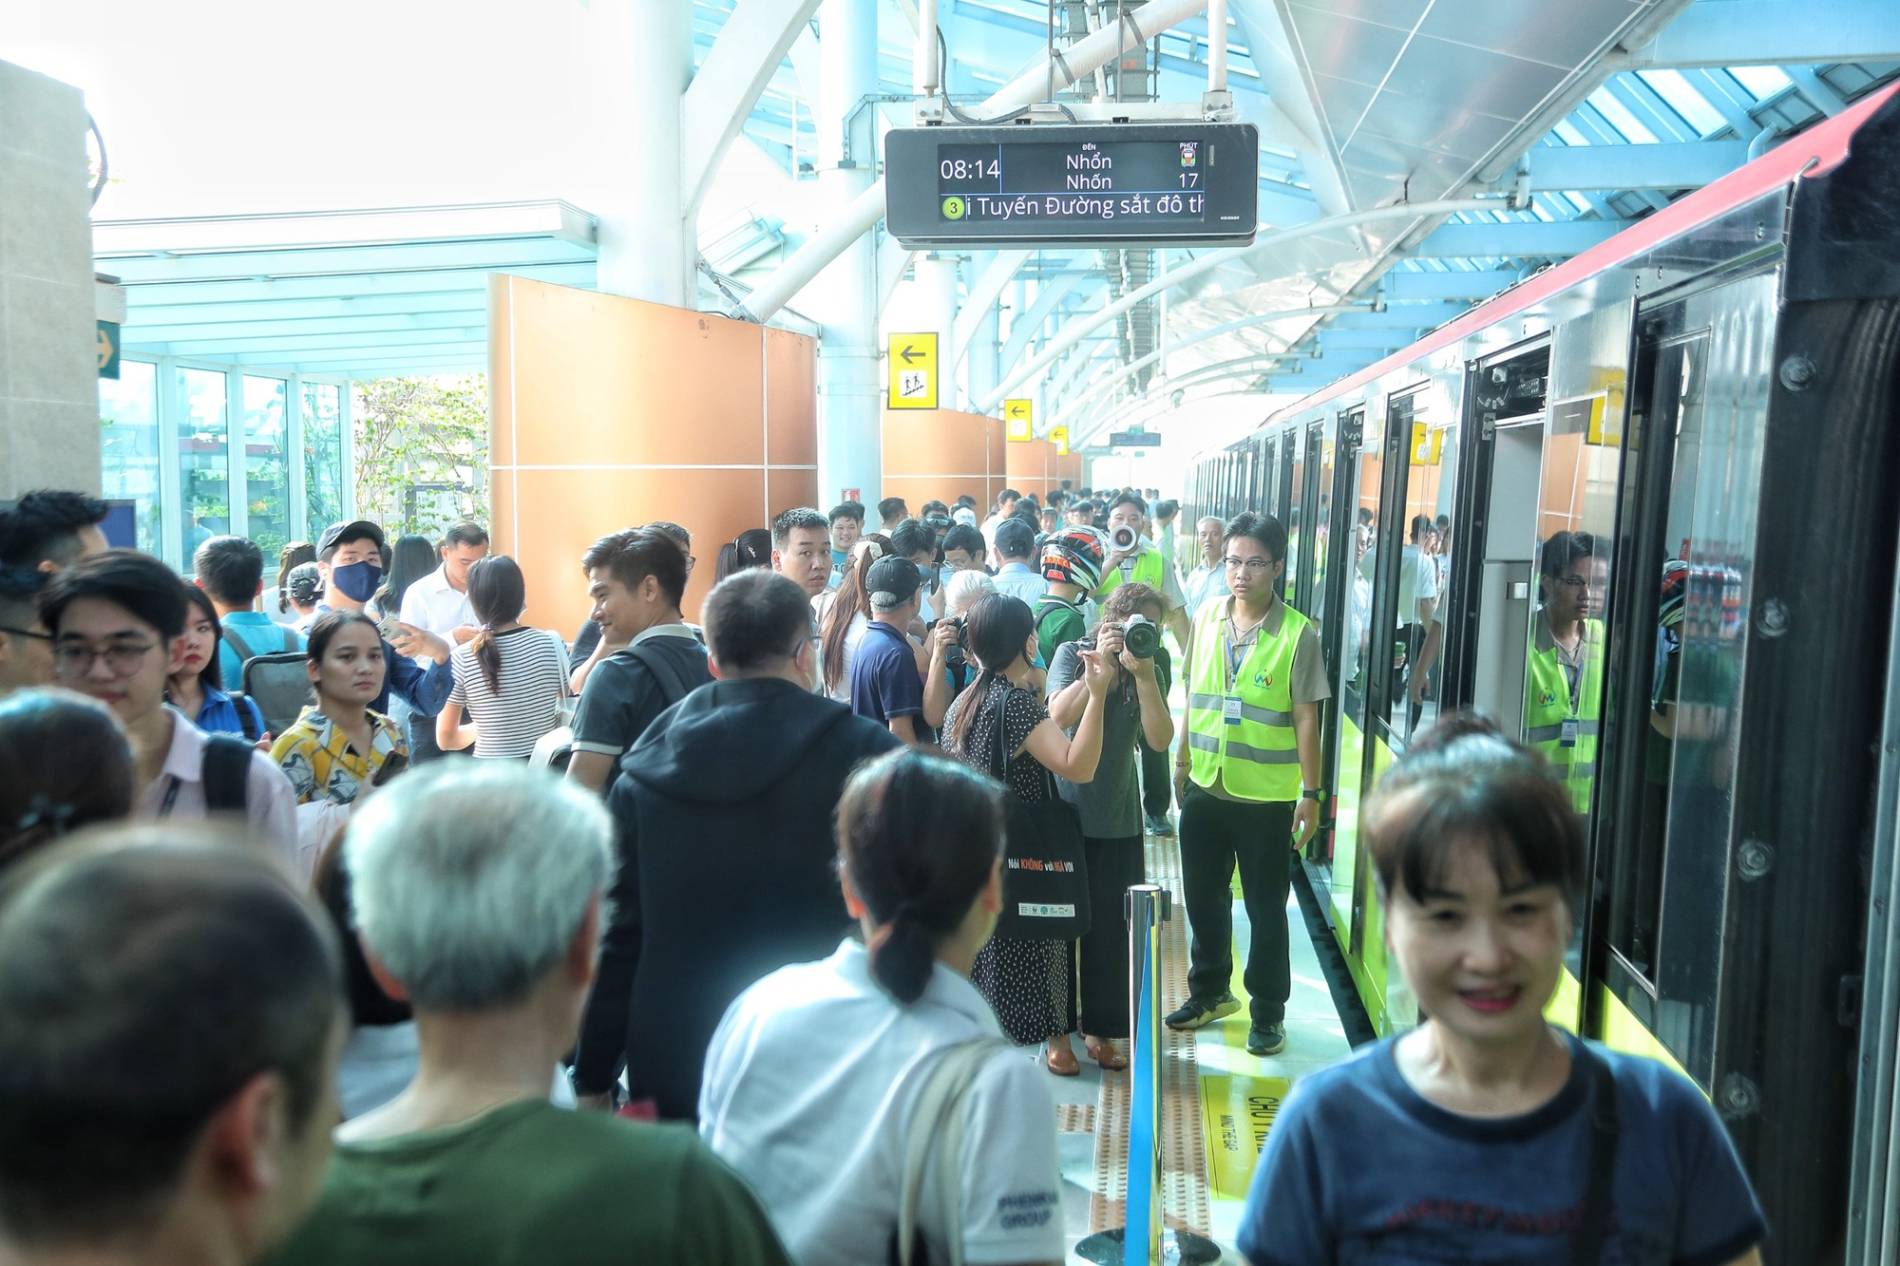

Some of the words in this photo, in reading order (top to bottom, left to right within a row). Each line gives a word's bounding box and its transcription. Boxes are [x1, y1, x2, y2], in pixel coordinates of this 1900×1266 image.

[940, 159, 1000, 180] 08:14
[1066, 151, 1112, 170] Nhổn
[1179, 173, 1199, 188] 17
[949, 201, 958, 214] 3
[977, 195, 1039, 220] Tuyến
[1045, 196, 1115, 219] Đường
[1120, 193, 1151, 214] sắt
[1156, 195, 1183, 214] đô
